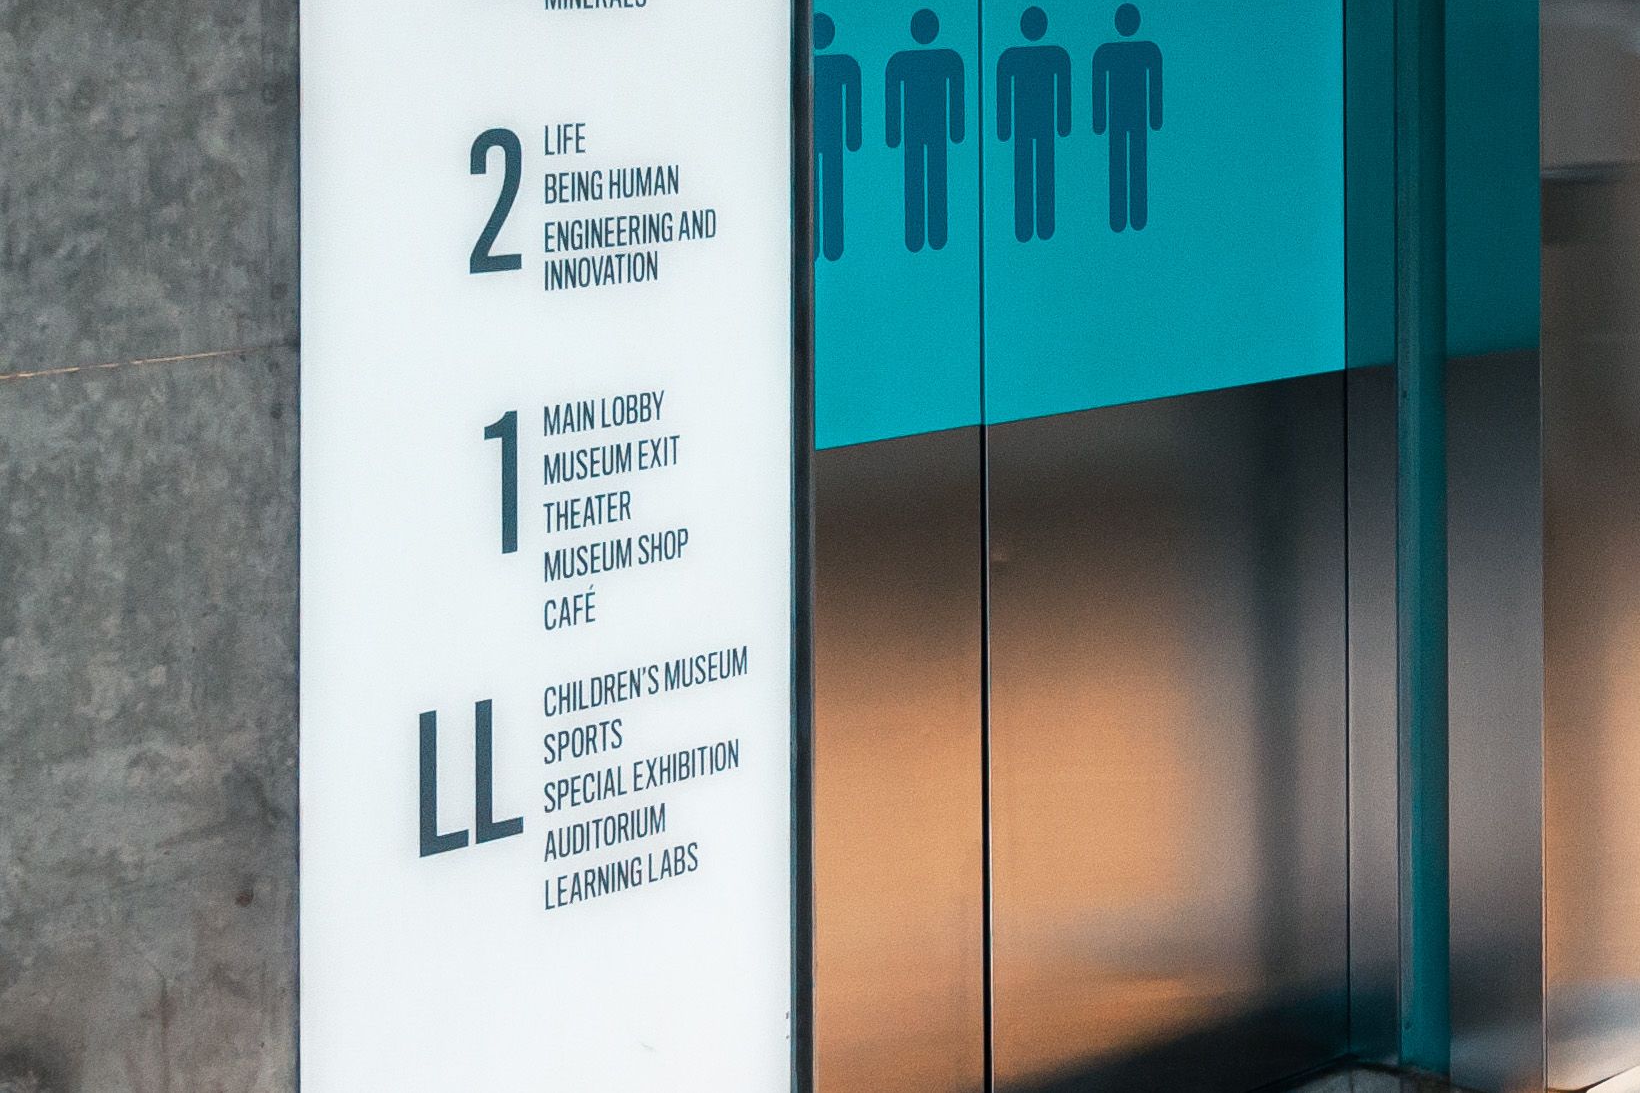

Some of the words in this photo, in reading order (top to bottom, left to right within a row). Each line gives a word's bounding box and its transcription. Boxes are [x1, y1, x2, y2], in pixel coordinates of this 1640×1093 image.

[544, 122, 587, 156] LIFE
[469, 127, 523, 274] 2
[544, 169, 603, 204] BEING
[608, 164, 680, 200] HUMAN
[544, 212, 673, 253] ENGINEERING
[678, 208, 717, 241] AND
[544, 250, 659, 291] INNOVATION
[542, 398, 595, 437] MAIN
[600, 390, 665, 429] LOBBY
[483, 409, 519, 554] 1
[542, 442, 632, 486] MUSEUM
[637, 434, 681, 471] EXIT
[542, 490, 632, 533] THEATER
[543, 538, 632, 583] MUSEUM
[637, 527, 689, 566] SHOP
[543, 583, 597, 631] CAFÉ
[543, 664, 660, 718] CHILDREN'S
[663, 645, 748, 690] MUSEUM
[543, 718, 623, 765] SPORTS
[419, 698, 524, 858] LL
[543, 765, 628, 814] SPECIAL
[632, 738, 740, 792] EXHIBITION
[543, 802, 667, 863] AUDITORIUM
[544, 855, 643, 911] LEARNING
[647, 841, 700, 884] LABS
